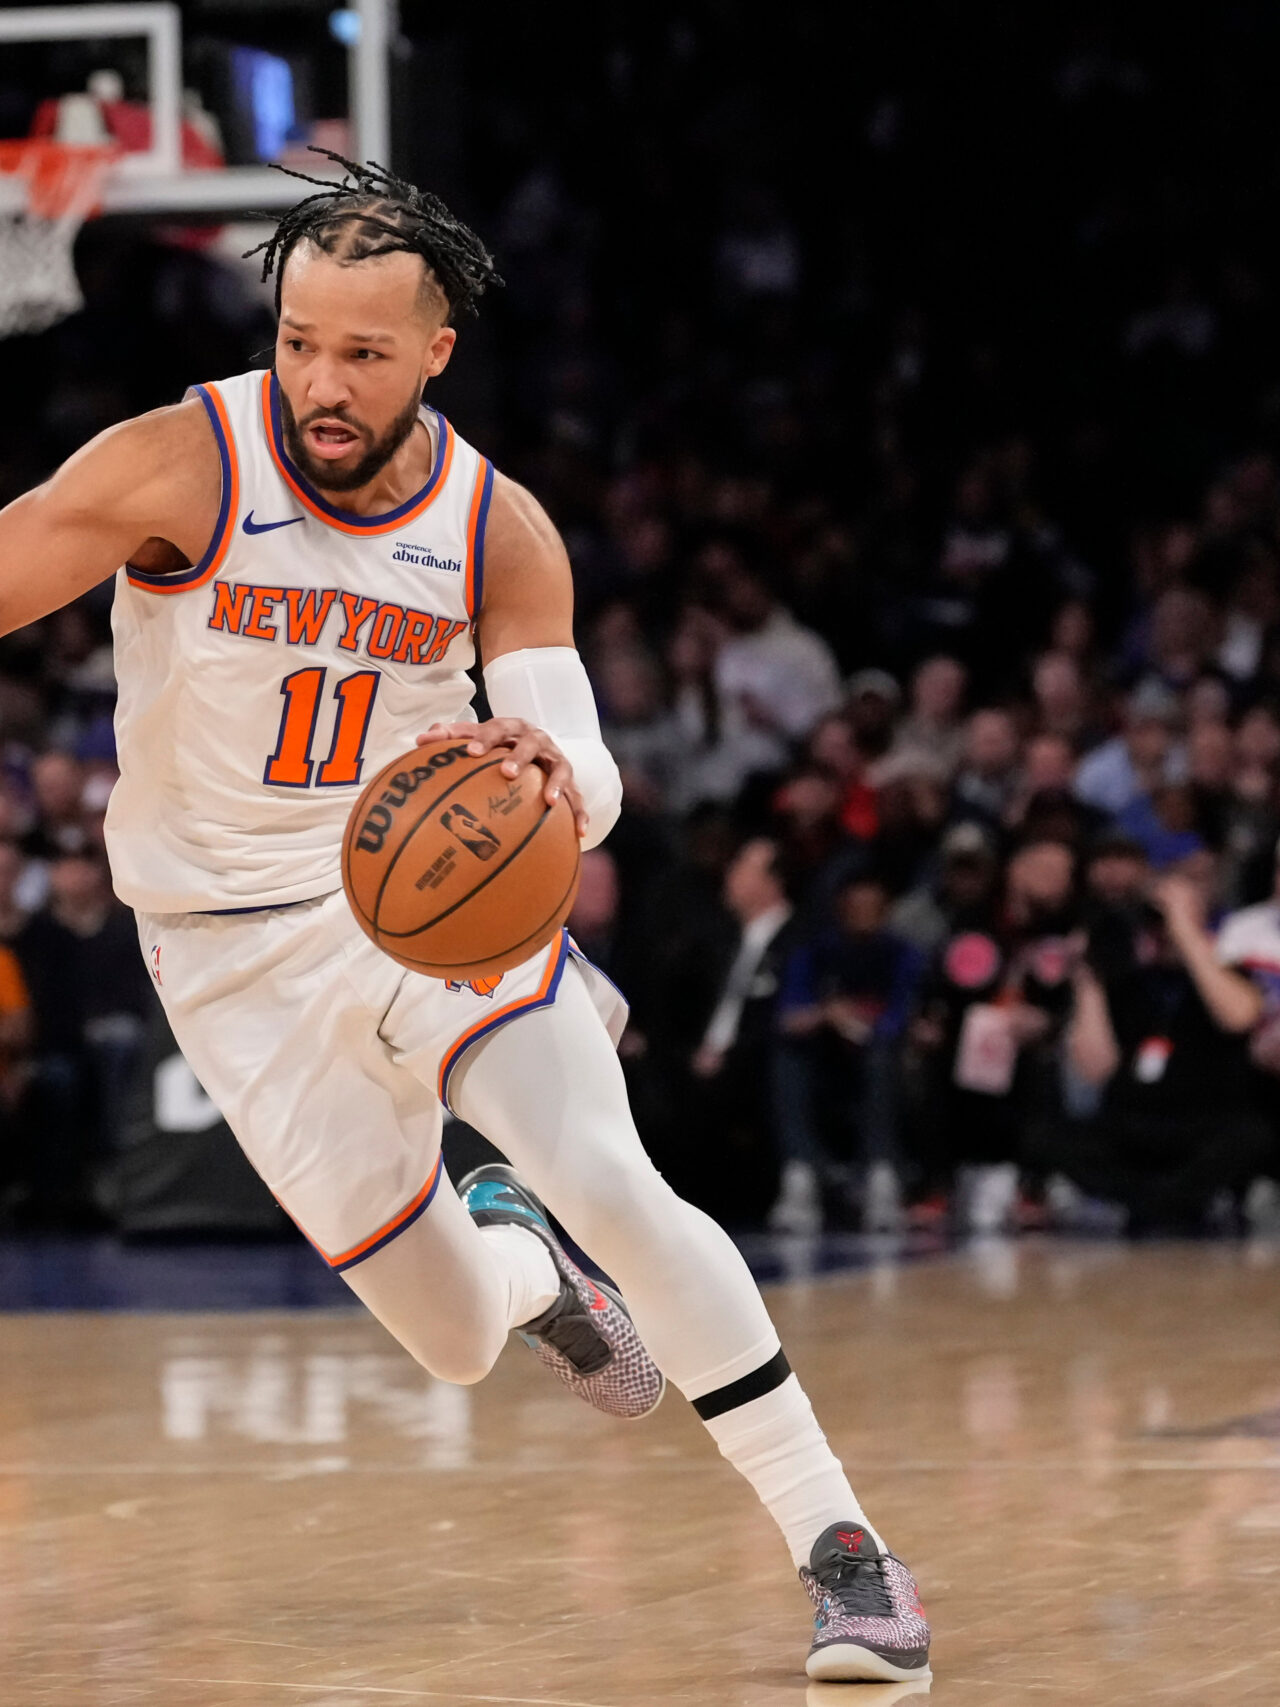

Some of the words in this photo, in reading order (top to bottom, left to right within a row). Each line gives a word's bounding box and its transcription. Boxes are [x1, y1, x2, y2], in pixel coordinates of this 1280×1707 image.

[392, 549, 420, 565] abu
[421, 554, 462, 573] dhabi
[395, 541, 433, 554] experience
[207, 580, 338, 646] NEW
[338, 589, 469, 665] YORK
[263, 666, 381, 789] 11
